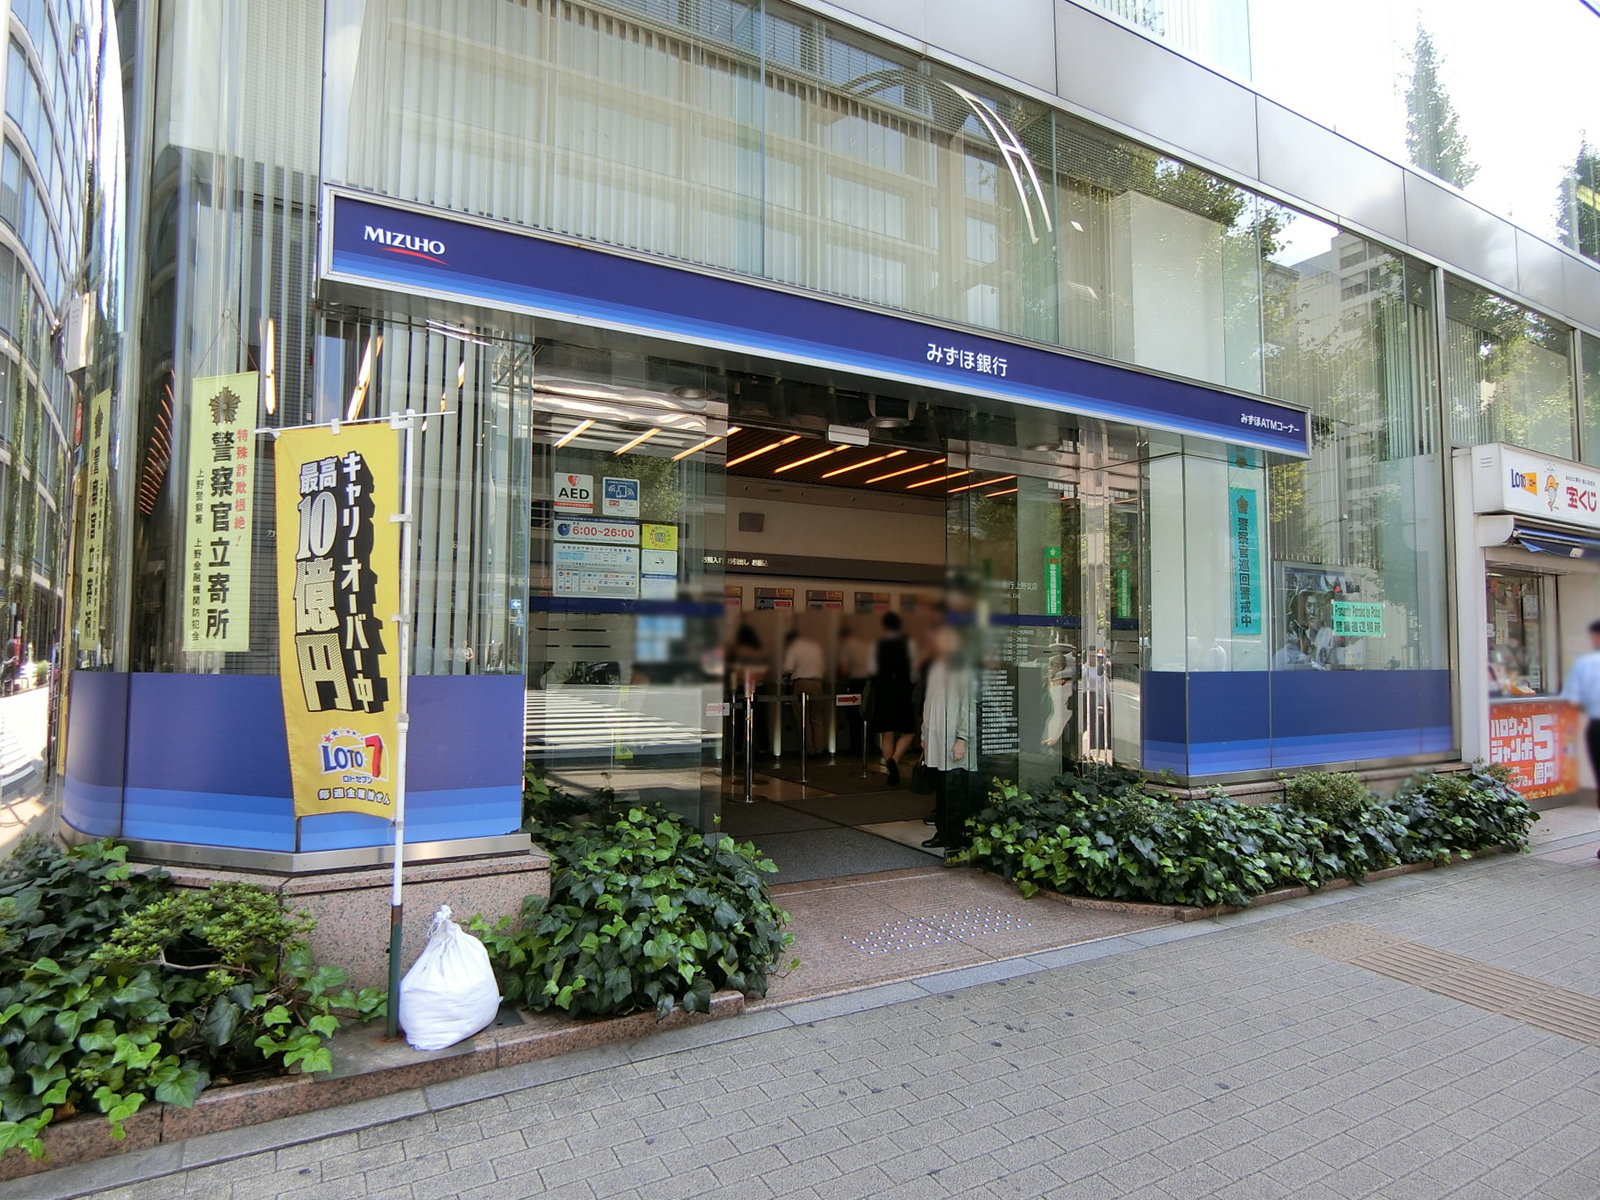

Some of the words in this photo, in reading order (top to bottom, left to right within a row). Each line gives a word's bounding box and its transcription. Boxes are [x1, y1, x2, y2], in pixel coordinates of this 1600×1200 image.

[363, 225, 446, 255] MIZUHO
[926, 343, 1008, 377] みずほ銀行
[1240, 413, 1300, 434] みずほATMコーナー
[300, 456, 339, 495] 最高
[1510, 468, 1527, 488] LOTO
[558, 487, 590, 500] AED
[1565, 485, 1597, 513] 宝くじ
[205, 430, 235, 640] 警察官立寄所
[341, 451, 374, 713] キャリーオーバー中
[1491, 716, 1532, 738] ハロウィン
[320, 744, 365, 773] LOTO
[364, 735, 384, 778] 7
[1491, 737, 1533, 763] ジャンボ
[342, 774, 374, 784] ロトセブン
